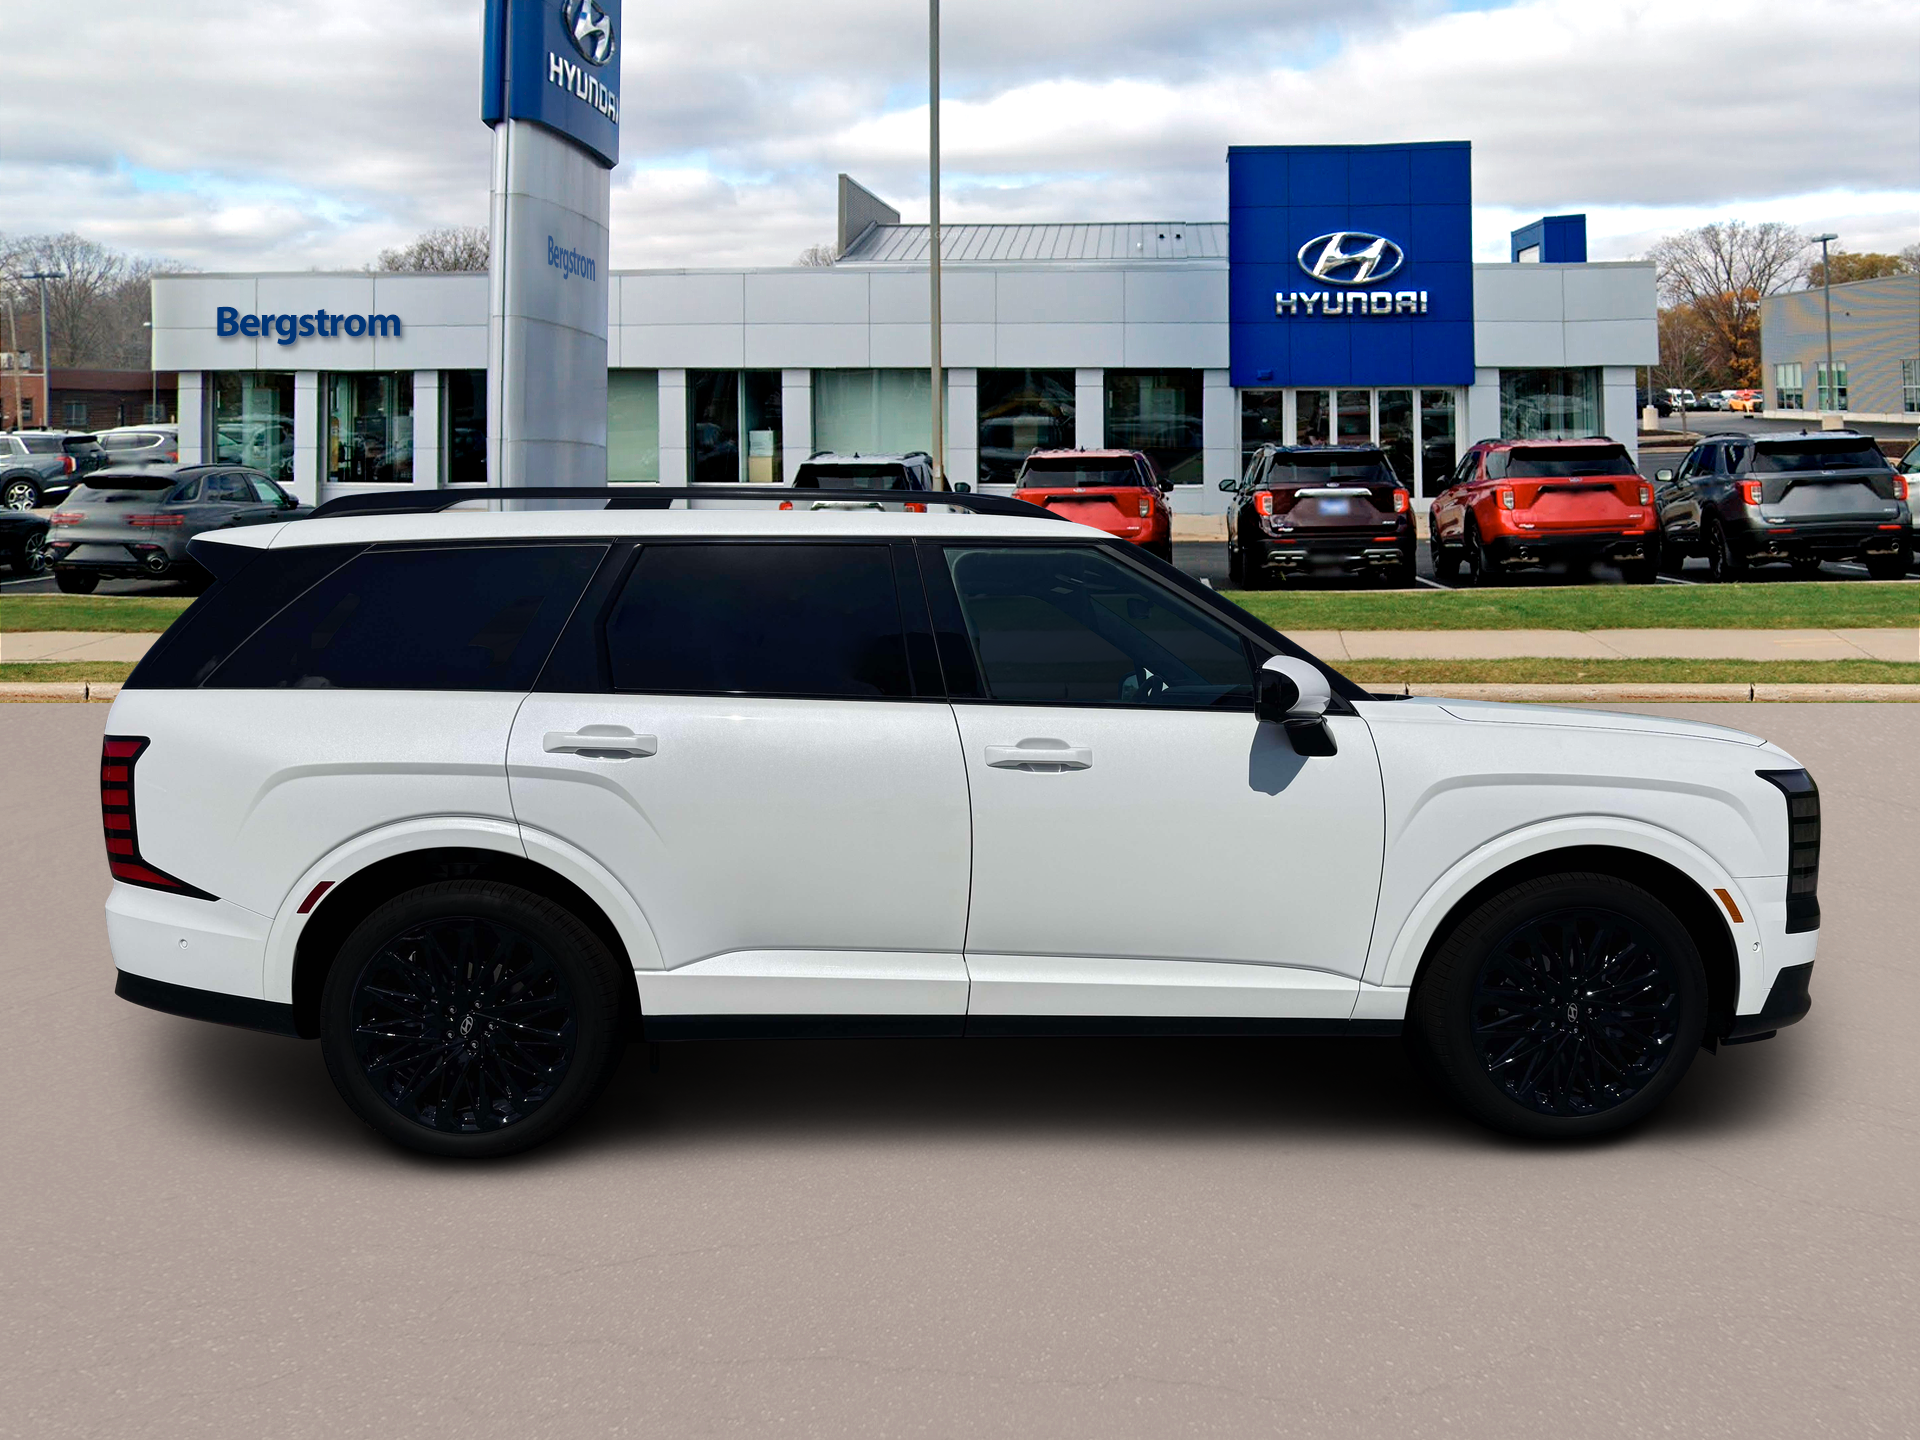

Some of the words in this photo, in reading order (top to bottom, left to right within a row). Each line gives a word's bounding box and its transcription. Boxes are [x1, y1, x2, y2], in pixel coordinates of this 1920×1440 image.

[549, 52, 619, 124] HYUNDAI
[547, 235, 596, 282] Bergstrom
[1275, 290, 1428, 315] HYUNDAI
[216, 306, 401, 346] Bergstrom
